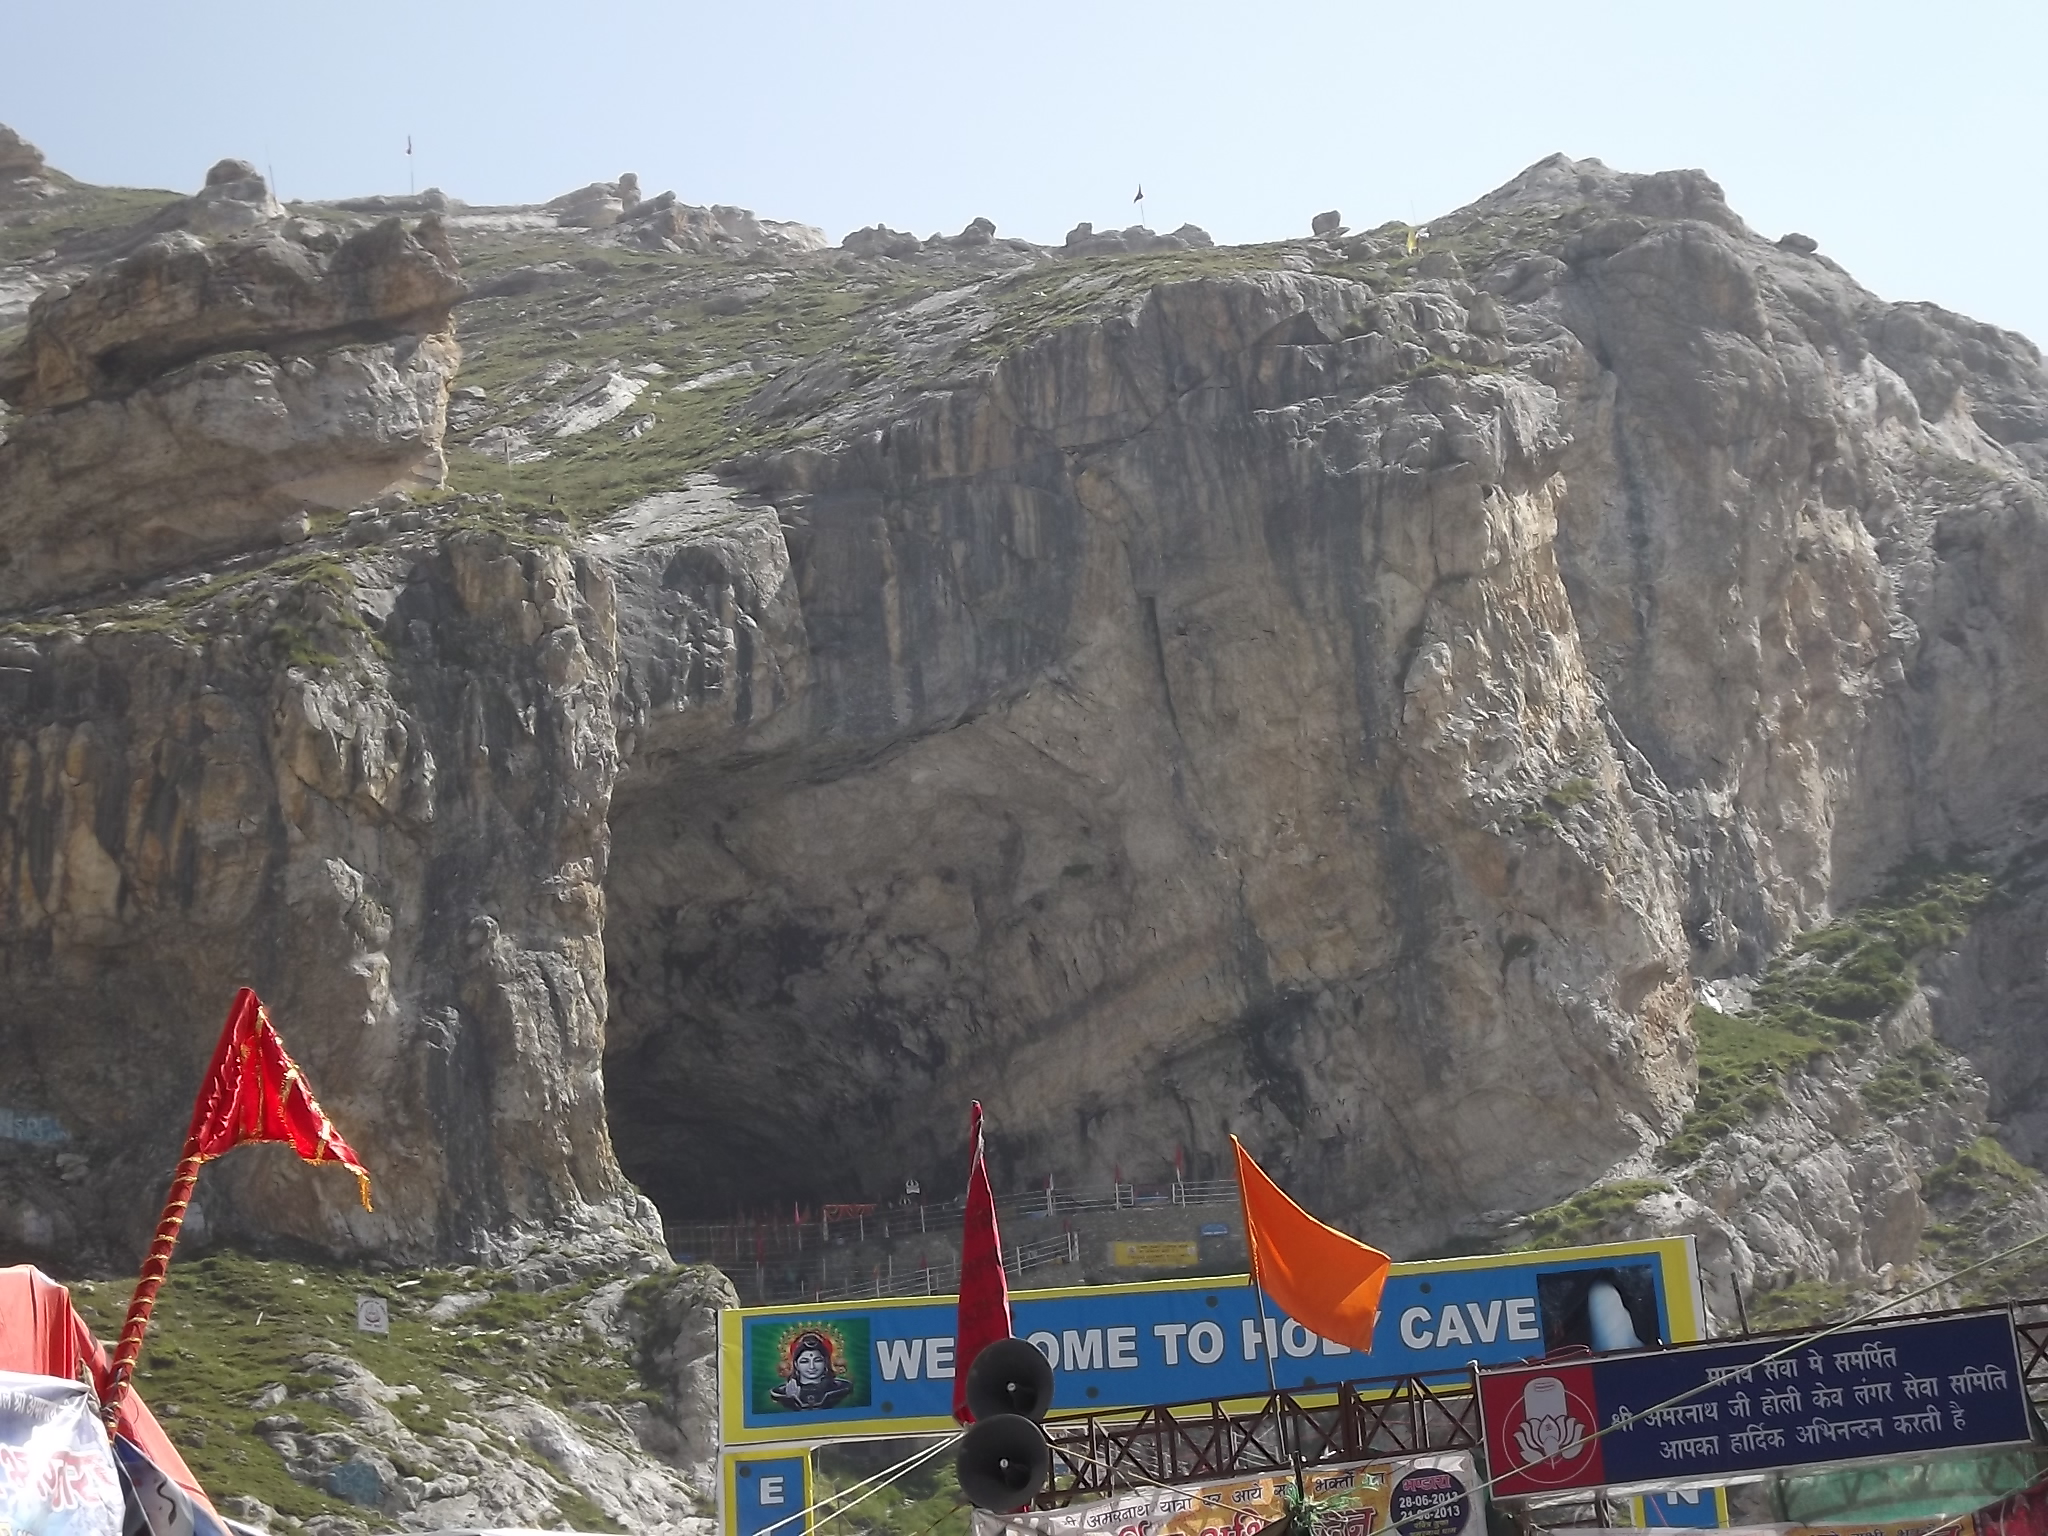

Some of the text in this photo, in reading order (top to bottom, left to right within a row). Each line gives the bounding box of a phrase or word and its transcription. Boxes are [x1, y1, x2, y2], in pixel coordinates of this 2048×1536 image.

[876, 1298, 1539, 1381] WEOME TO HO CAVE
[1764, 1353, 1798, 1381] सेवा
[1808, 1349, 1824, 1374] मे
[1833, 1341, 1898, 1373] समर्पित
[1645, 1401, 1718, 1428] अमरनाथ
[1728, 1391, 1751, 1418] जी
[1760, 1385, 1802, 1416] होली
[1811, 1382, 1843, 1409] केव
[1853, 1377, 1894, 1405] लंगर
[1902, 1372, 1939, 1400] सेवा
[1948, 1364, 2008, 1395] समिति
[1659, 1401, 1966, 1460] आपका हार्दिक अभिनन्दन करती है
[760, 1476, 785, 1505] E
[1087, 1504, 1151, 1527] अमरनाथ
[1160, 1498, 1192, 1514] यात्रा
[1231, 1484, 1263, 1503] आये
